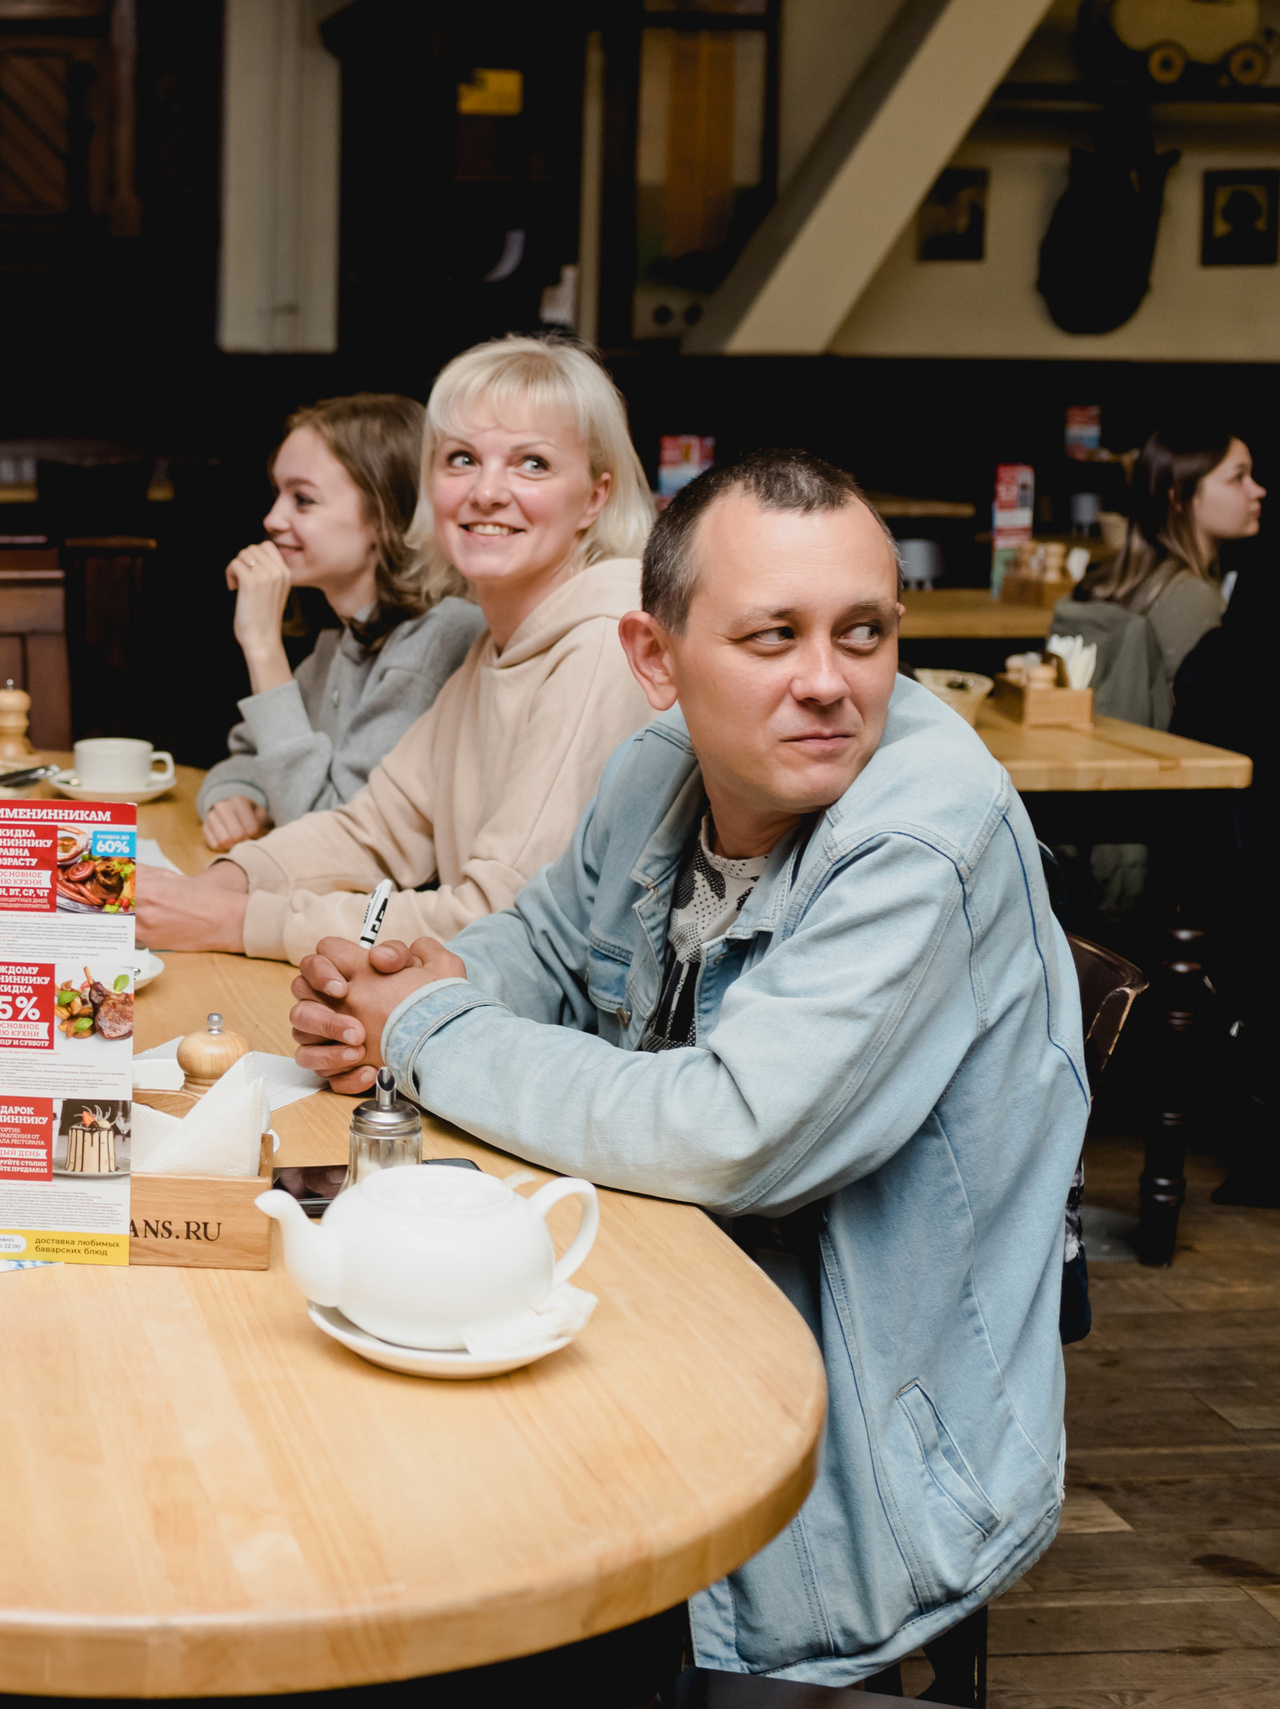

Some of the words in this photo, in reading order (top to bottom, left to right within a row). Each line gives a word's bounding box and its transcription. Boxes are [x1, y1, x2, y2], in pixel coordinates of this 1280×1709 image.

[96, 840, 130, 853] 60%
[9, 888, 22, 897] ВТ,
[22, 889, 36, 897] СР,
[36, 889, 49, 897] ЧТ
[77, 1239, 120, 1247] любимых
[35, 1245, 81, 1254] баварских
[84, 1248, 108, 1256] блюд
